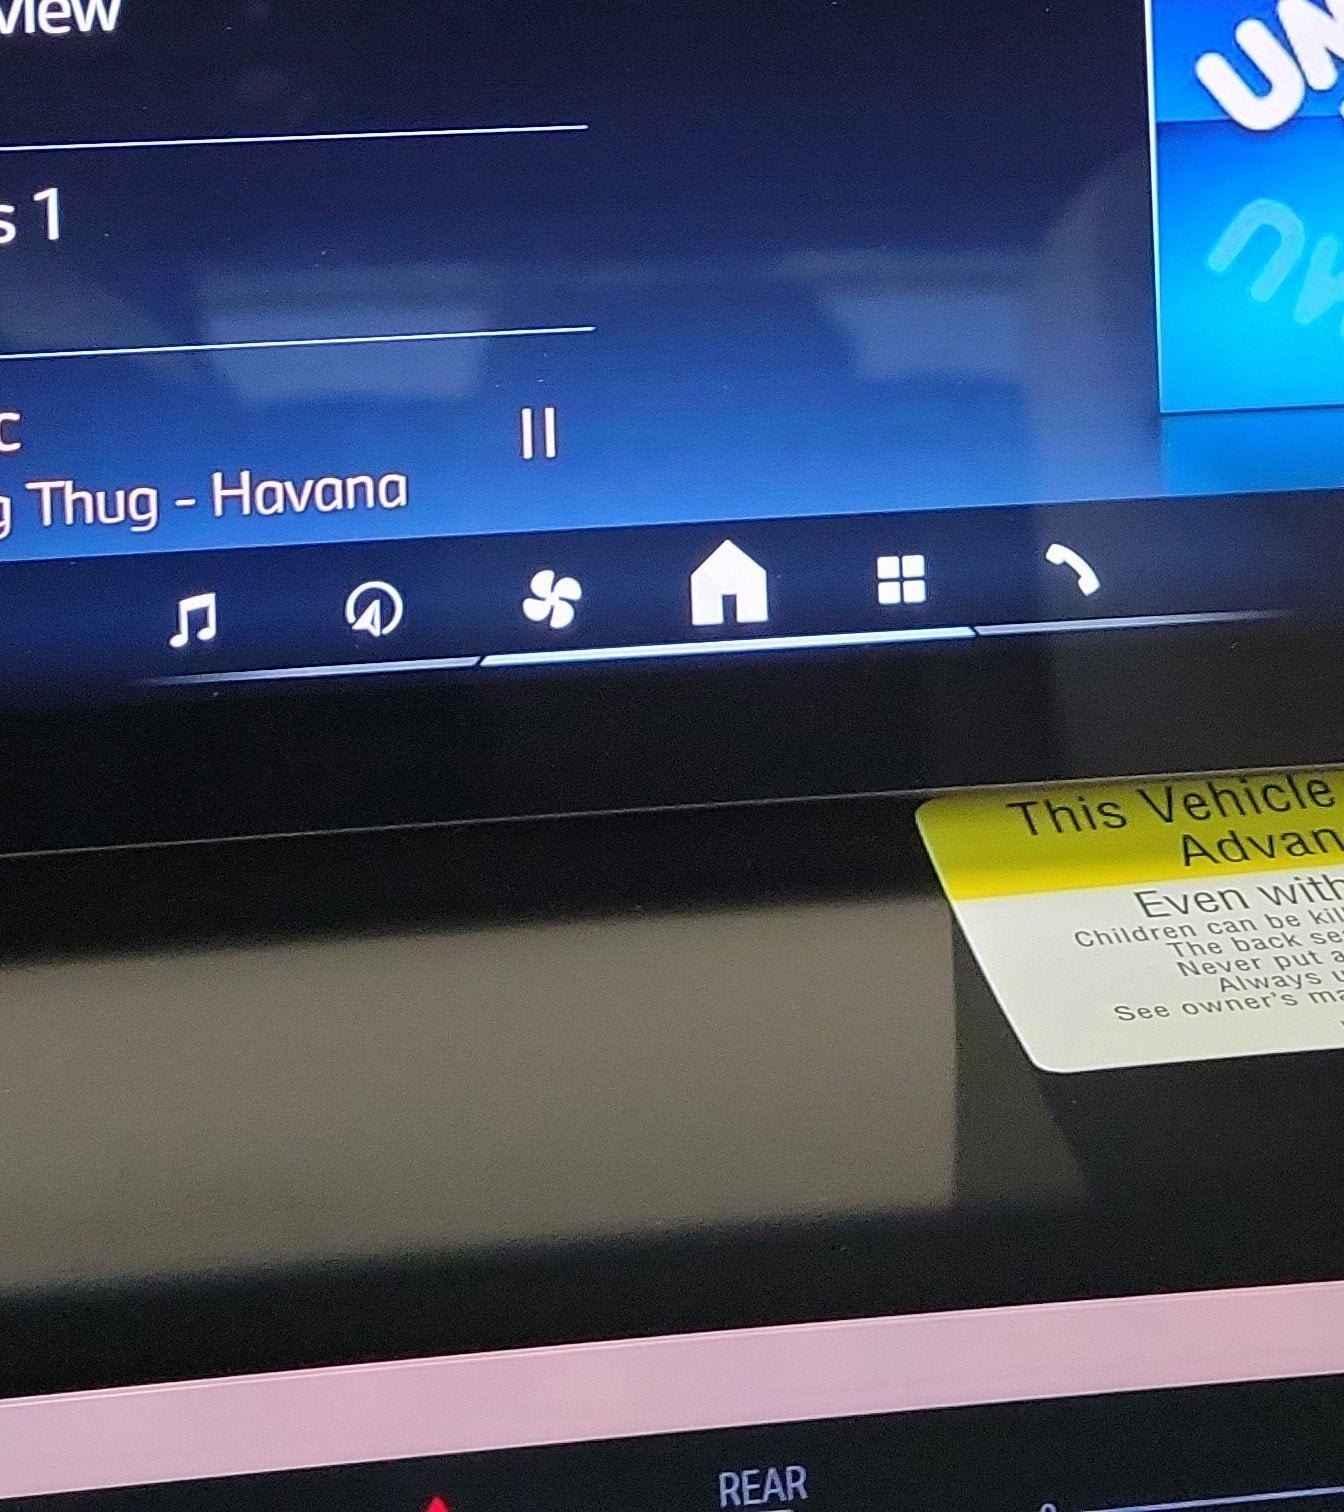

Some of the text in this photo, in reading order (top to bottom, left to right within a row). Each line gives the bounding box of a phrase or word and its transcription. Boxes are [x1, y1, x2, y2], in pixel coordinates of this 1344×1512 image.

[33, 187, 60, 241] 1
[25, 480, 158, 531] Thug
[211, 468, 408, 518] Havana
[1006, 798, 1128, 837] This
[1140, 773, 1336, 825] Vehicle
[1134, 888, 1251, 920] Even
[1074, 921, 1198, 949] Children
[1207, 919, 1258, 935] can
[1264, 911, 1301, 930] be
[1166, 938, 1224, 960] The
[1232, 931, 1302, 953] back
[1175, 957, 1263, 979] Never
[1273, 951, 1323, 971] put
[1218, 971, 1322, 993] Always
[1113, 1001, 1171, 1022] See
[1180, 991, 1299, 1015] owner's
[718, 1464, 809, 1508] REAR
